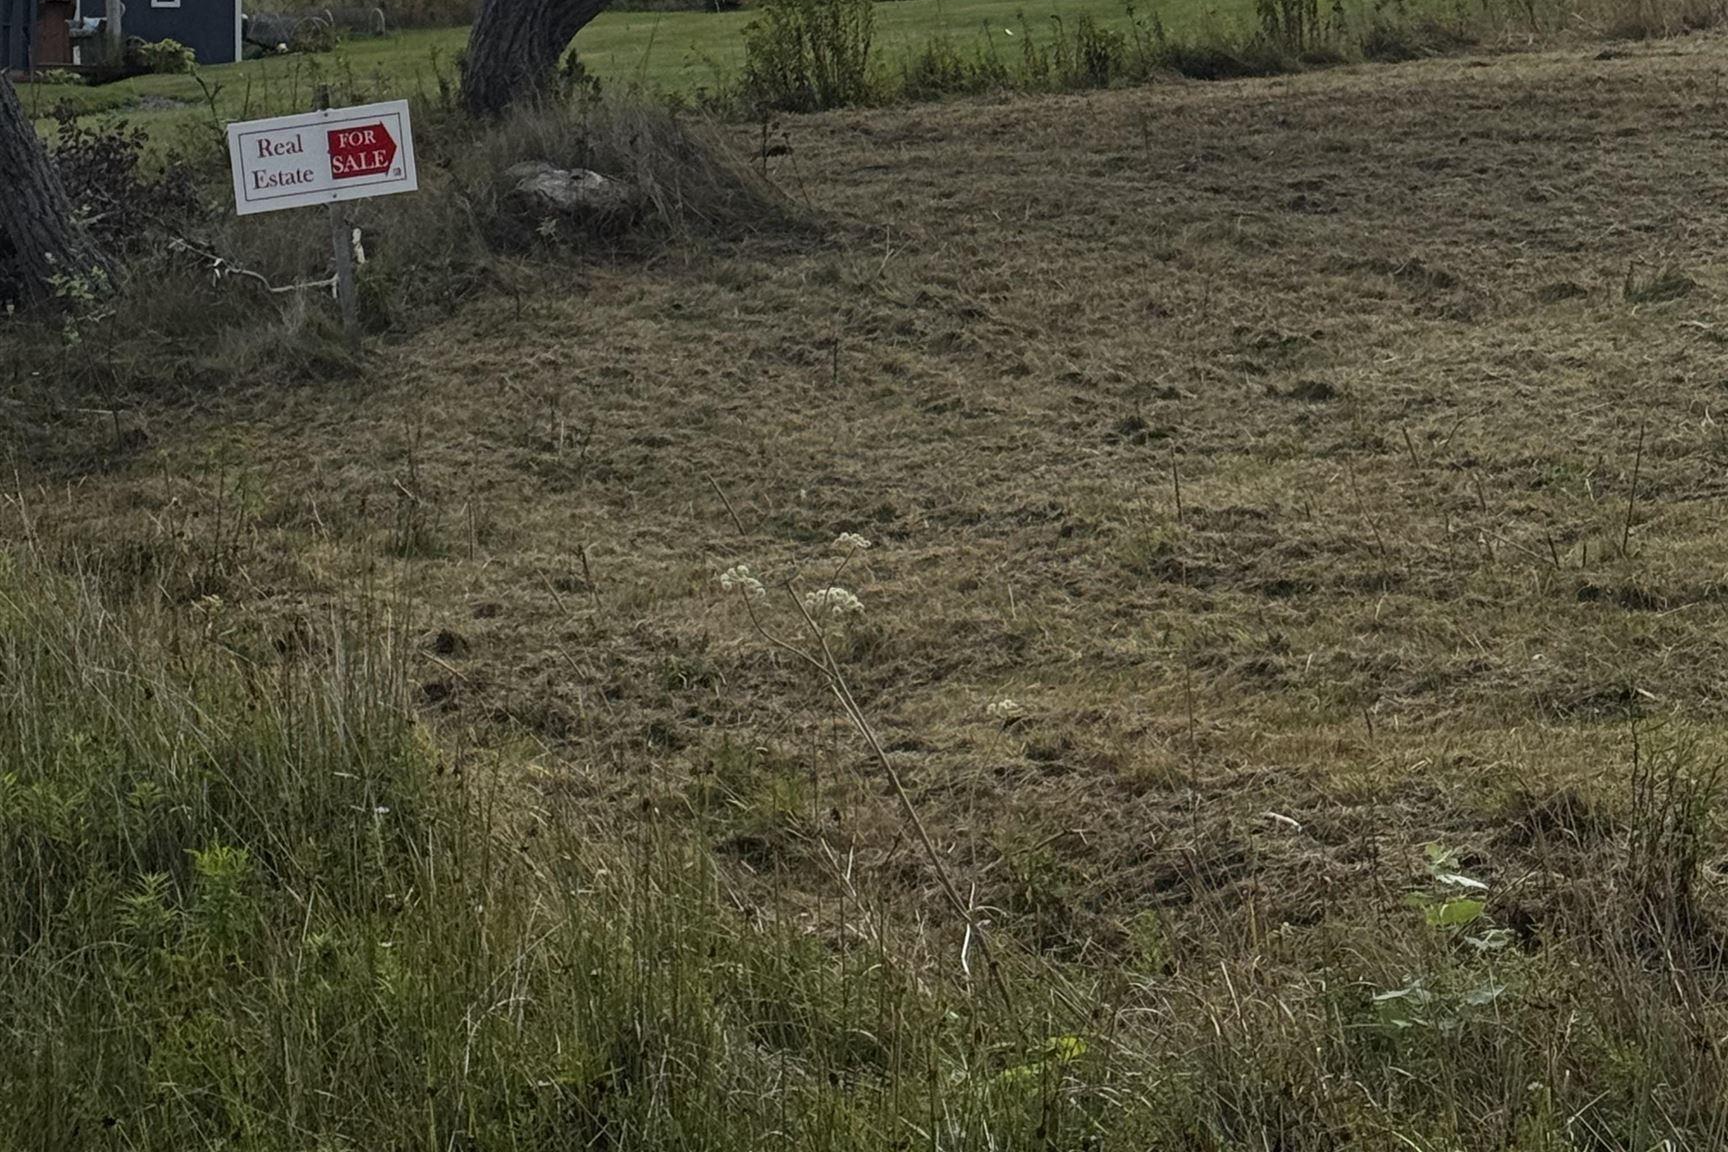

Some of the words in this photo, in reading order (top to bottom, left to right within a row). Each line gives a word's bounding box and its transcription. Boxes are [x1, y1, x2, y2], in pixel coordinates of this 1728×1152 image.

[257, 134, 304, 159] Real
[338, 130, 376, 148] FOR
[332, 149, 389, 174] SALE
[252, 167, 314, 189] Estate
